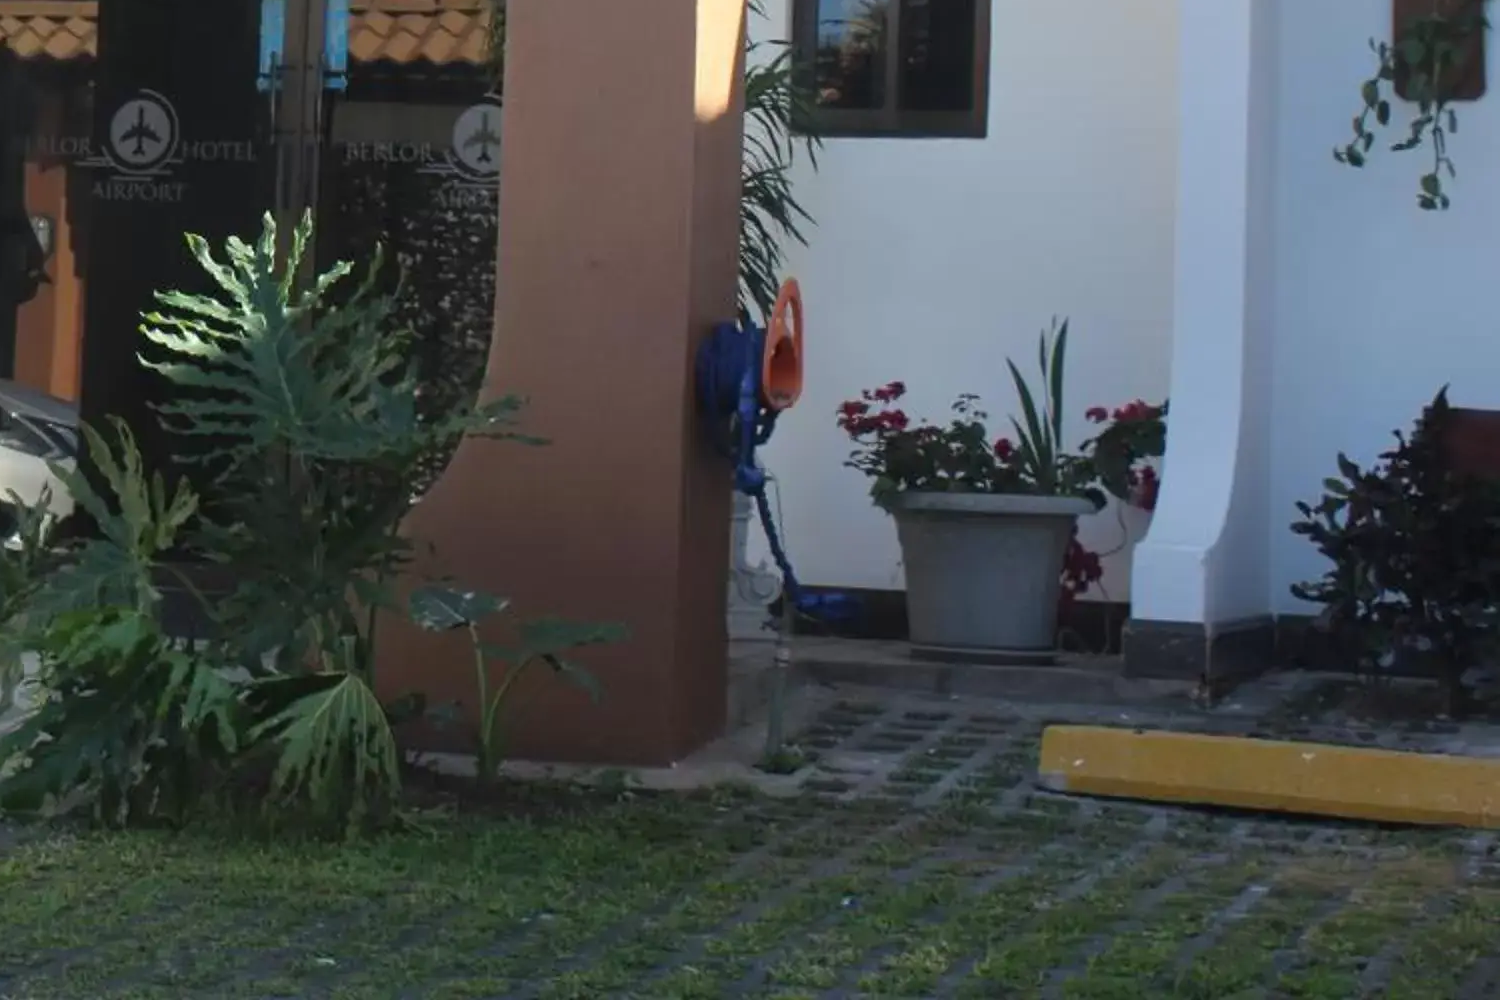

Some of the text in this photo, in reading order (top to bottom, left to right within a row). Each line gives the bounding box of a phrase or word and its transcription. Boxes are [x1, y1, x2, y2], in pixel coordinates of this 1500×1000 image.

[182, 140, 257, 162] HOTEL
[345, 140, 435, 163] BERLOR
[92, 181, 187, 202] AIRPORT
